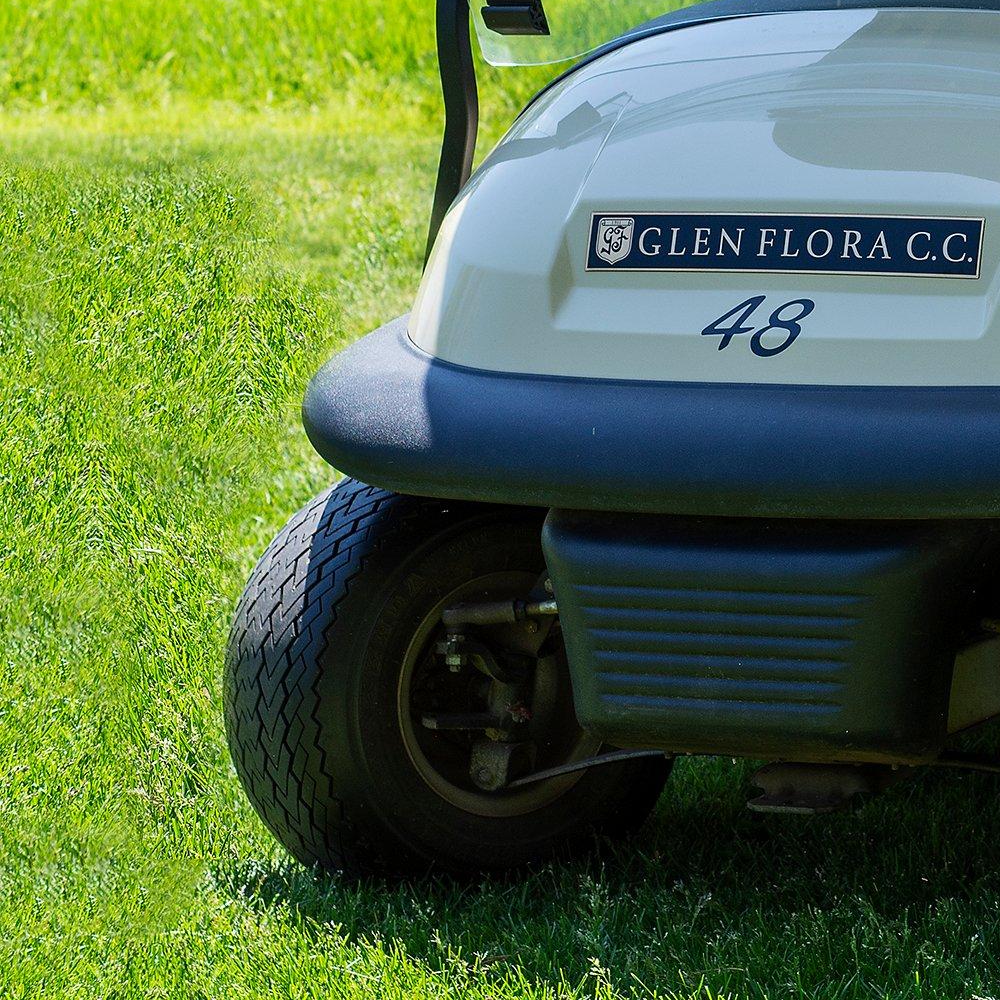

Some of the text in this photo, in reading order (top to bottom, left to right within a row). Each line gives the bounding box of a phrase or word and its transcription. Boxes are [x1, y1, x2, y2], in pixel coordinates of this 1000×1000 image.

[637, 227, 974, 264] GLEN FLORA C.C.
[700, 294, 816, 358] 48
